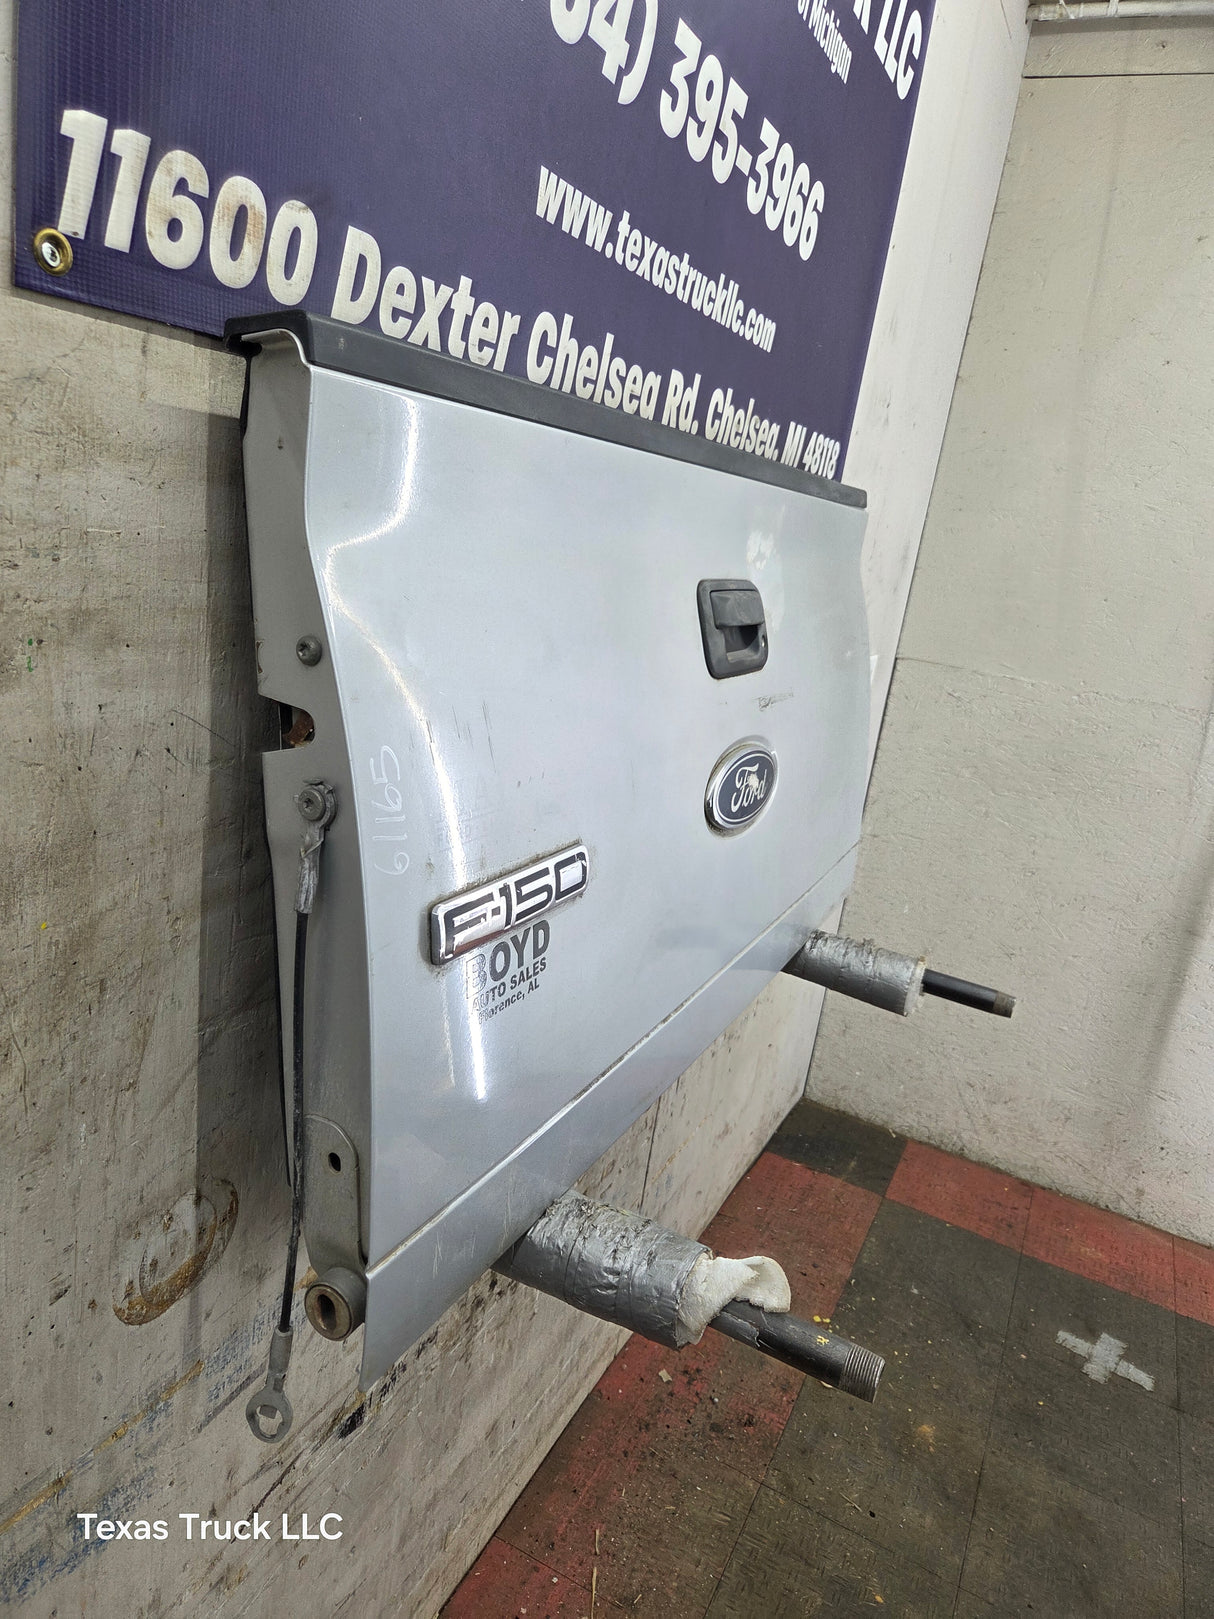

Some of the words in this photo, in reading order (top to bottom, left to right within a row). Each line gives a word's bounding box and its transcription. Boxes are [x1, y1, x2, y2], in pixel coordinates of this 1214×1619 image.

[660, 17, 825, 261] 395-3966
[56, 109, 319, 306] 11600
[330, 225, 521, 373] Dexter
[526, 311, 662, 421] Chelsea
[661, 368, 699, 436] Rd.
[780, 421, 808, 469] MI
[802, 431, 841, 480] 48118
[535, 165, 777, 353] www.texastruckllc.com
[369, 745, 410, 876] 61165
[730, 763, 768, 813] Ford
[441, 850, 588, 960] F-150
[466, 920, 550, 999] BOYD
[473, 982, 507, 1011] AUTO
[510, 957, 547, 990] SALES
[527, 978, 540, 994] AL
